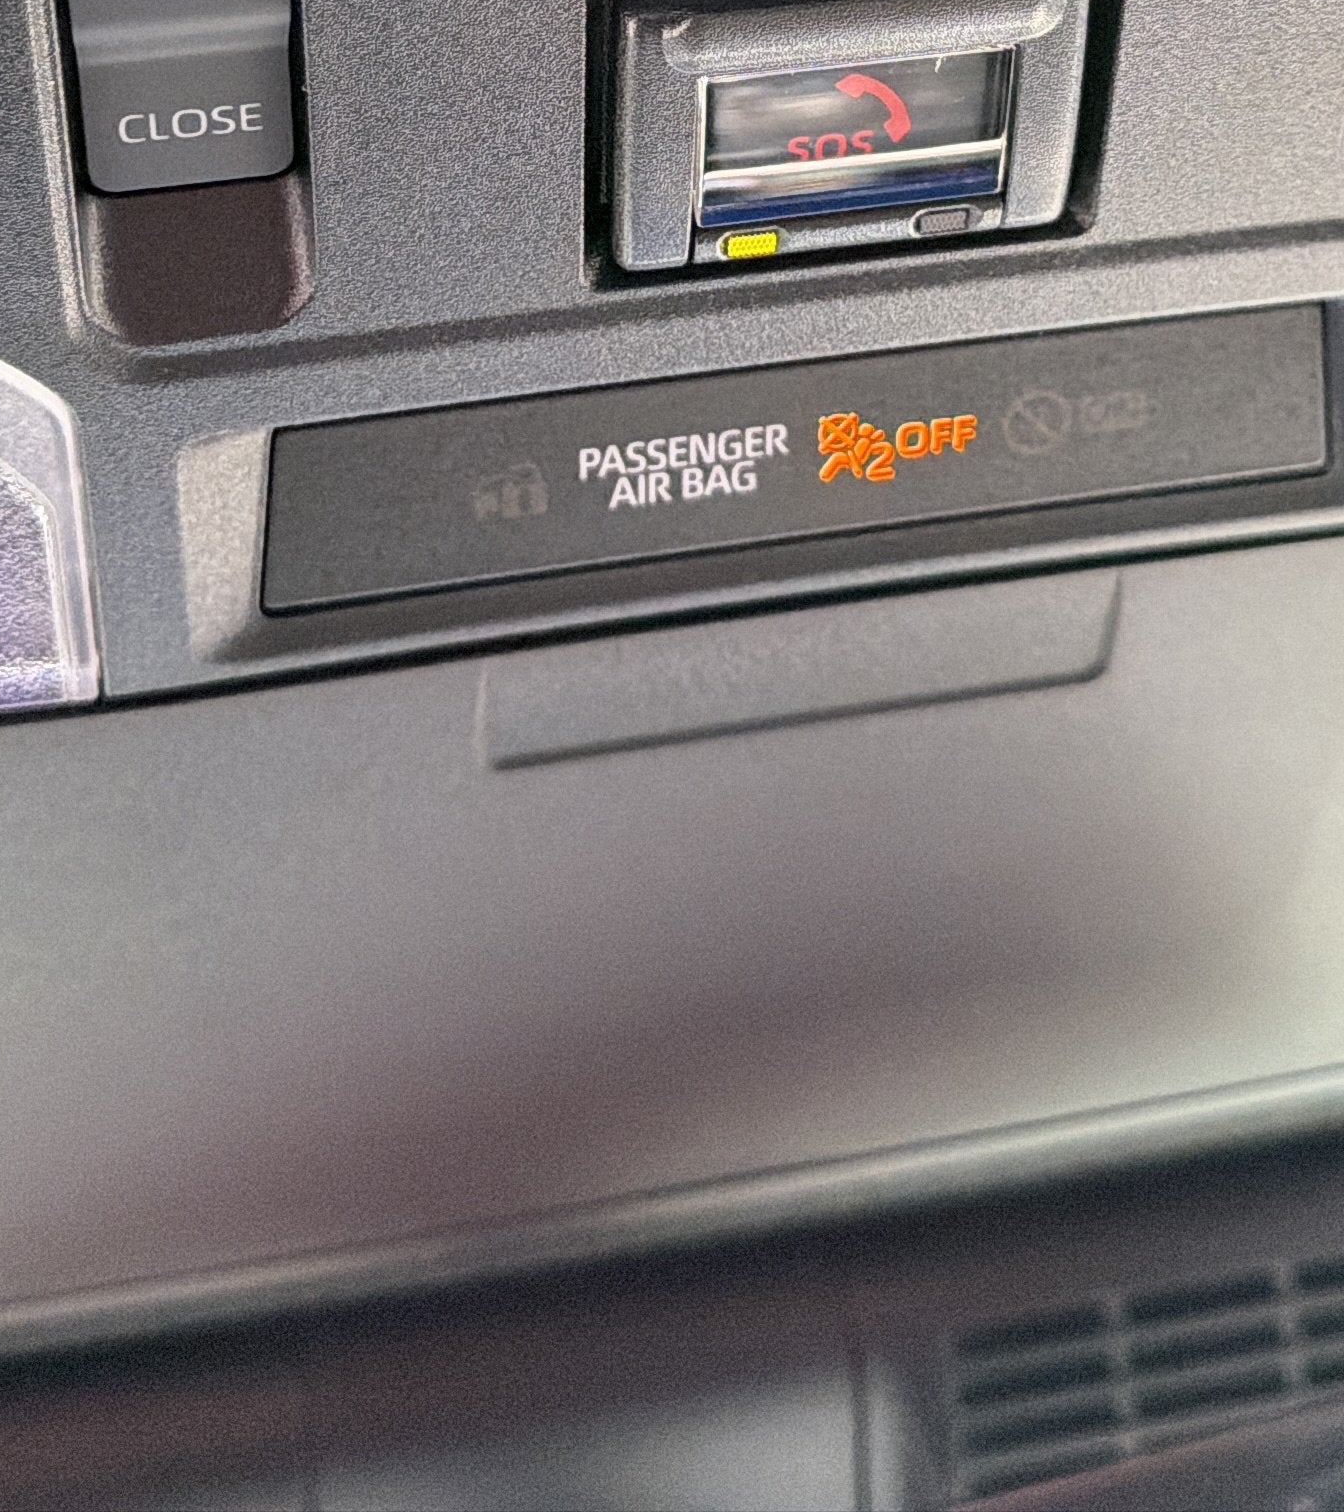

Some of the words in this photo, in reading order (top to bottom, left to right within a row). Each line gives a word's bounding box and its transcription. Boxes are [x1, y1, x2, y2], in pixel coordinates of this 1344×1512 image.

[118, 103, 263, 145] CLOSE
[578, 423, 789, 482] PASSENGER
[895, 414, 978, 459] OFF
[608, 471, 672, 510] AIR
[681, 460, 757, 500] BAG
